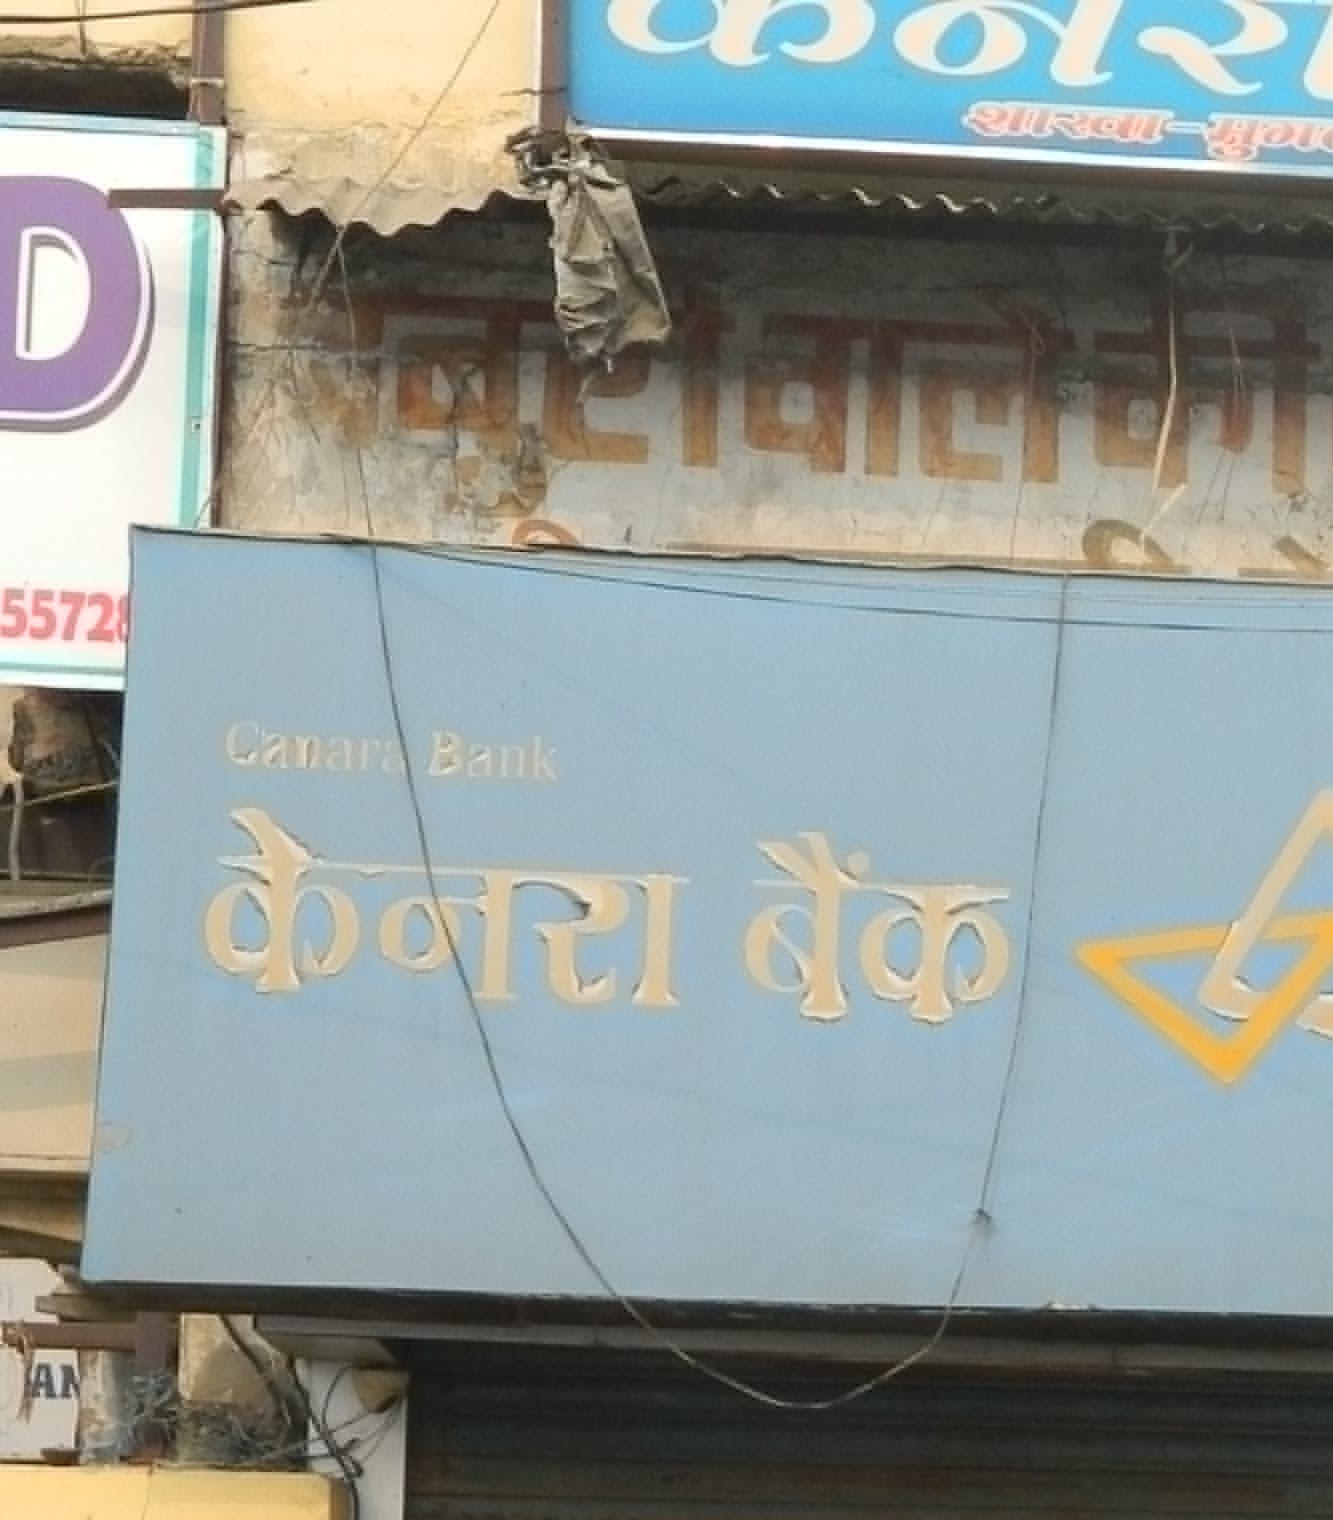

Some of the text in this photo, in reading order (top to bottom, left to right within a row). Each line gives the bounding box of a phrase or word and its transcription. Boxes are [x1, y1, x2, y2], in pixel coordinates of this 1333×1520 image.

[224, 719, 560, 782] Canara Bank
[205, 806, 1012, 1025] केनरा बैंक
